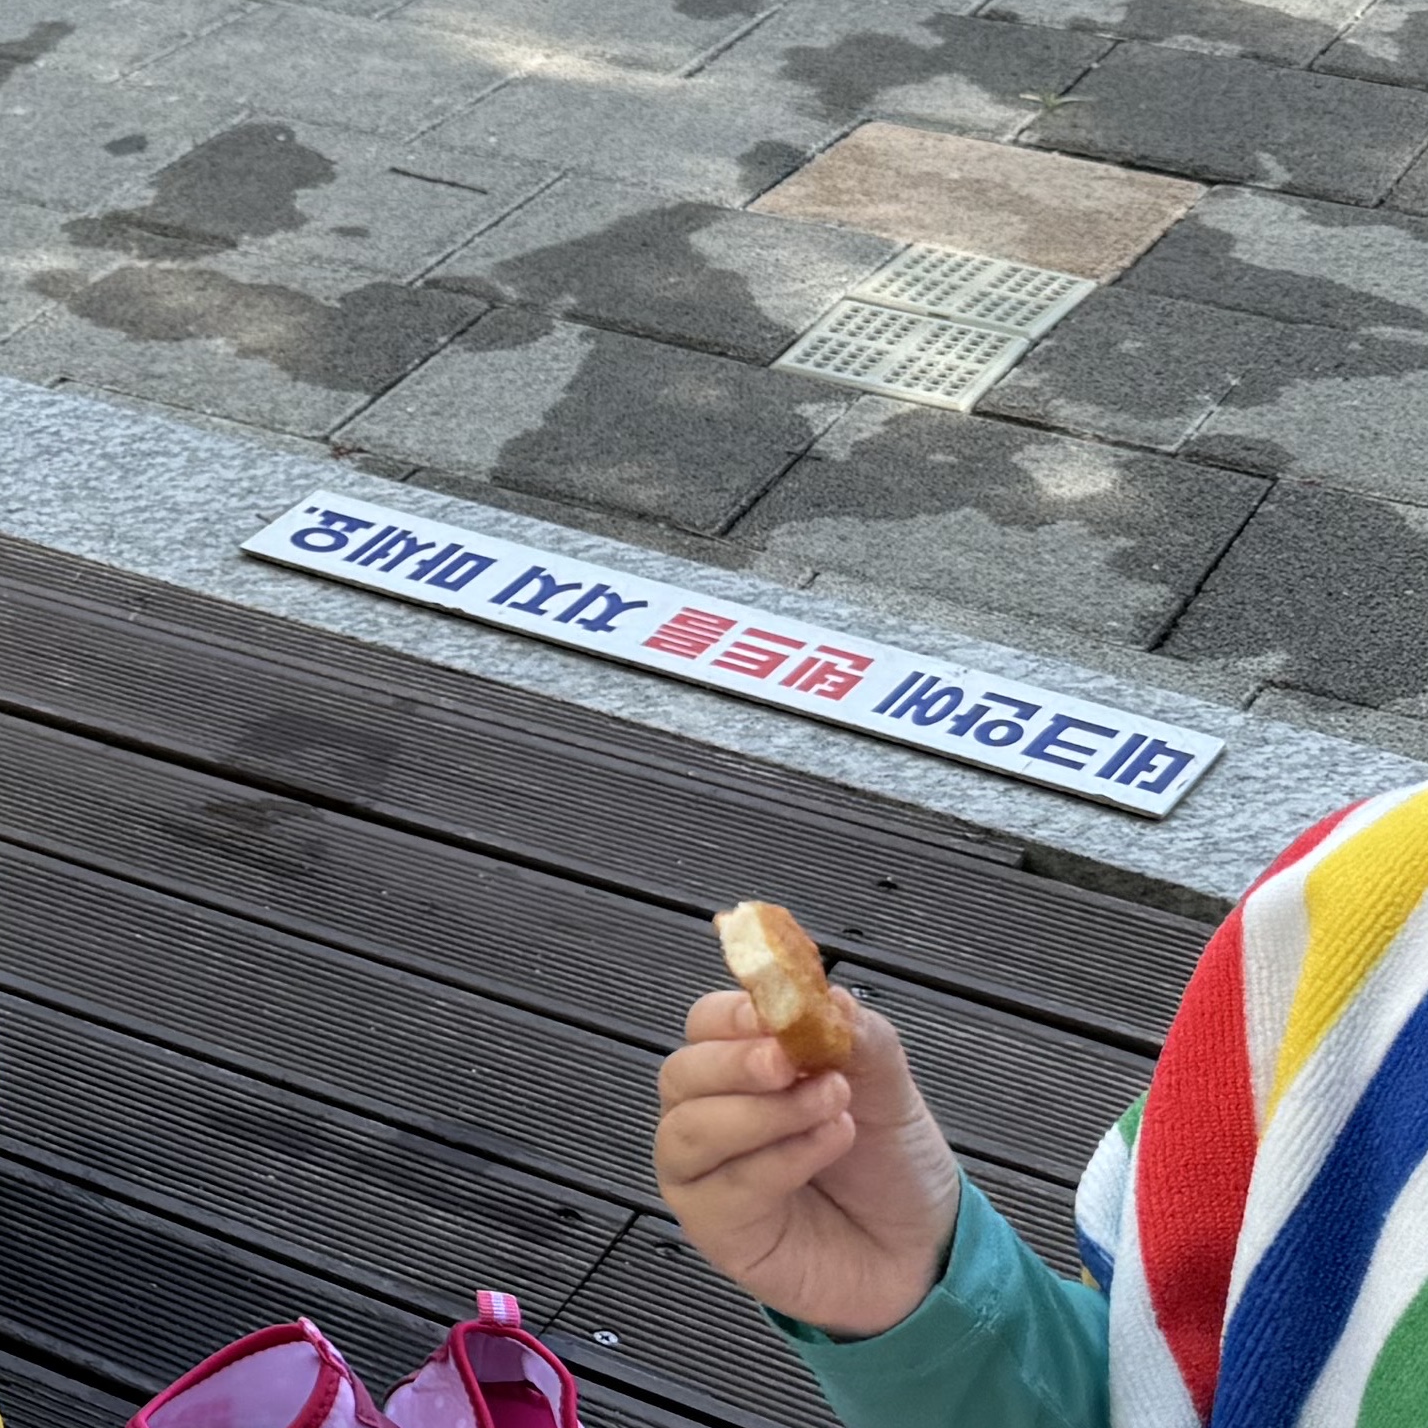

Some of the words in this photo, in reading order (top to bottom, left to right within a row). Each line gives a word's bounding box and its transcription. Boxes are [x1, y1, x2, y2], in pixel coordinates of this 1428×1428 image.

[290, 506, 497, 593] 마세요.
[491, 566, 649, 632] 치지
[645, 609, 872, 700] 텐트를
[874, 670, 1195, 794] 데크안에
